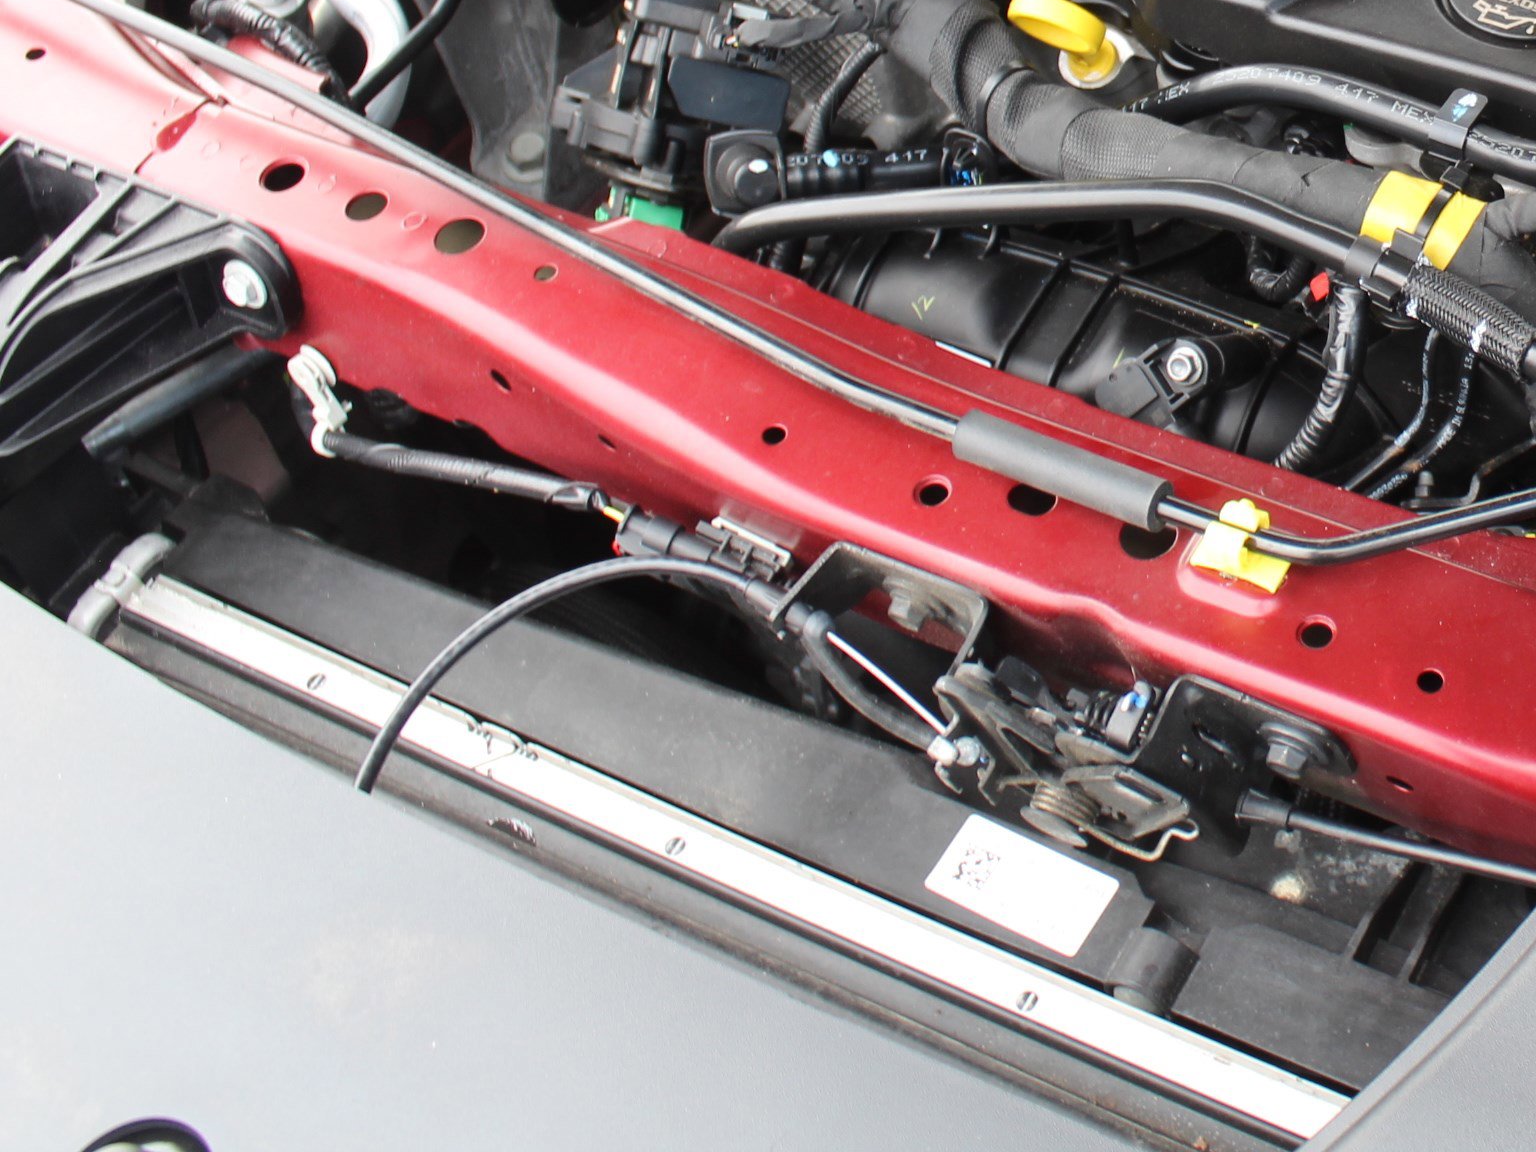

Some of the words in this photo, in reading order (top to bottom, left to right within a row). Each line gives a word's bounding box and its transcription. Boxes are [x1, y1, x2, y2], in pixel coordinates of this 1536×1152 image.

[1335, 83, 1380, 104] 417
[1391, 100, 1435, 126] MEX
[884, 148, 928, 164] 417
